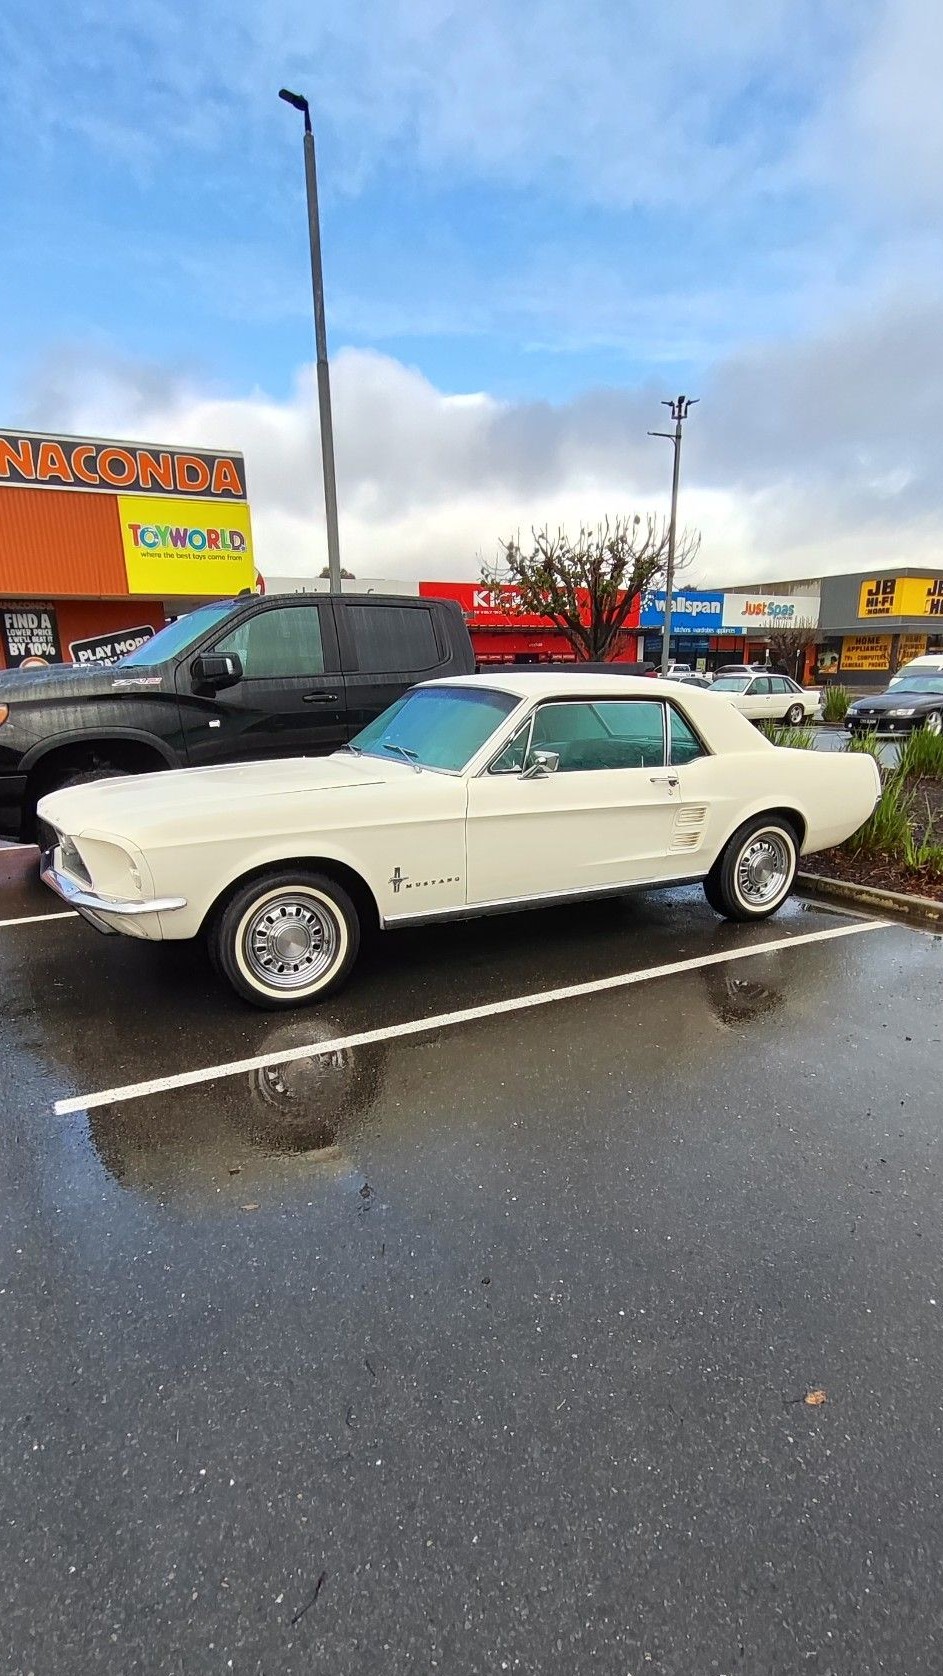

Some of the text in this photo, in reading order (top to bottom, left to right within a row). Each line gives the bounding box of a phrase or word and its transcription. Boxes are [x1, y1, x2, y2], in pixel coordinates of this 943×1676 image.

[128, 524, 245, 551] TOYWORLD
[141, 551, 161, 559] where
[163, 551, 175, 559] the
[176, 552, 191, 560] best
[193, 553, 206, 561] toys
[227, 554, 242, 562] from
[867, 579, 896, 596] JB
[655, 597, 720, 616] wallspan
[4, 614, 51, 628] FIND A
[9, 643, 56, 655] BY 10%
[78, 645, 112, 662] PLAY
[406, 877, 460, 888] MUSTANG
